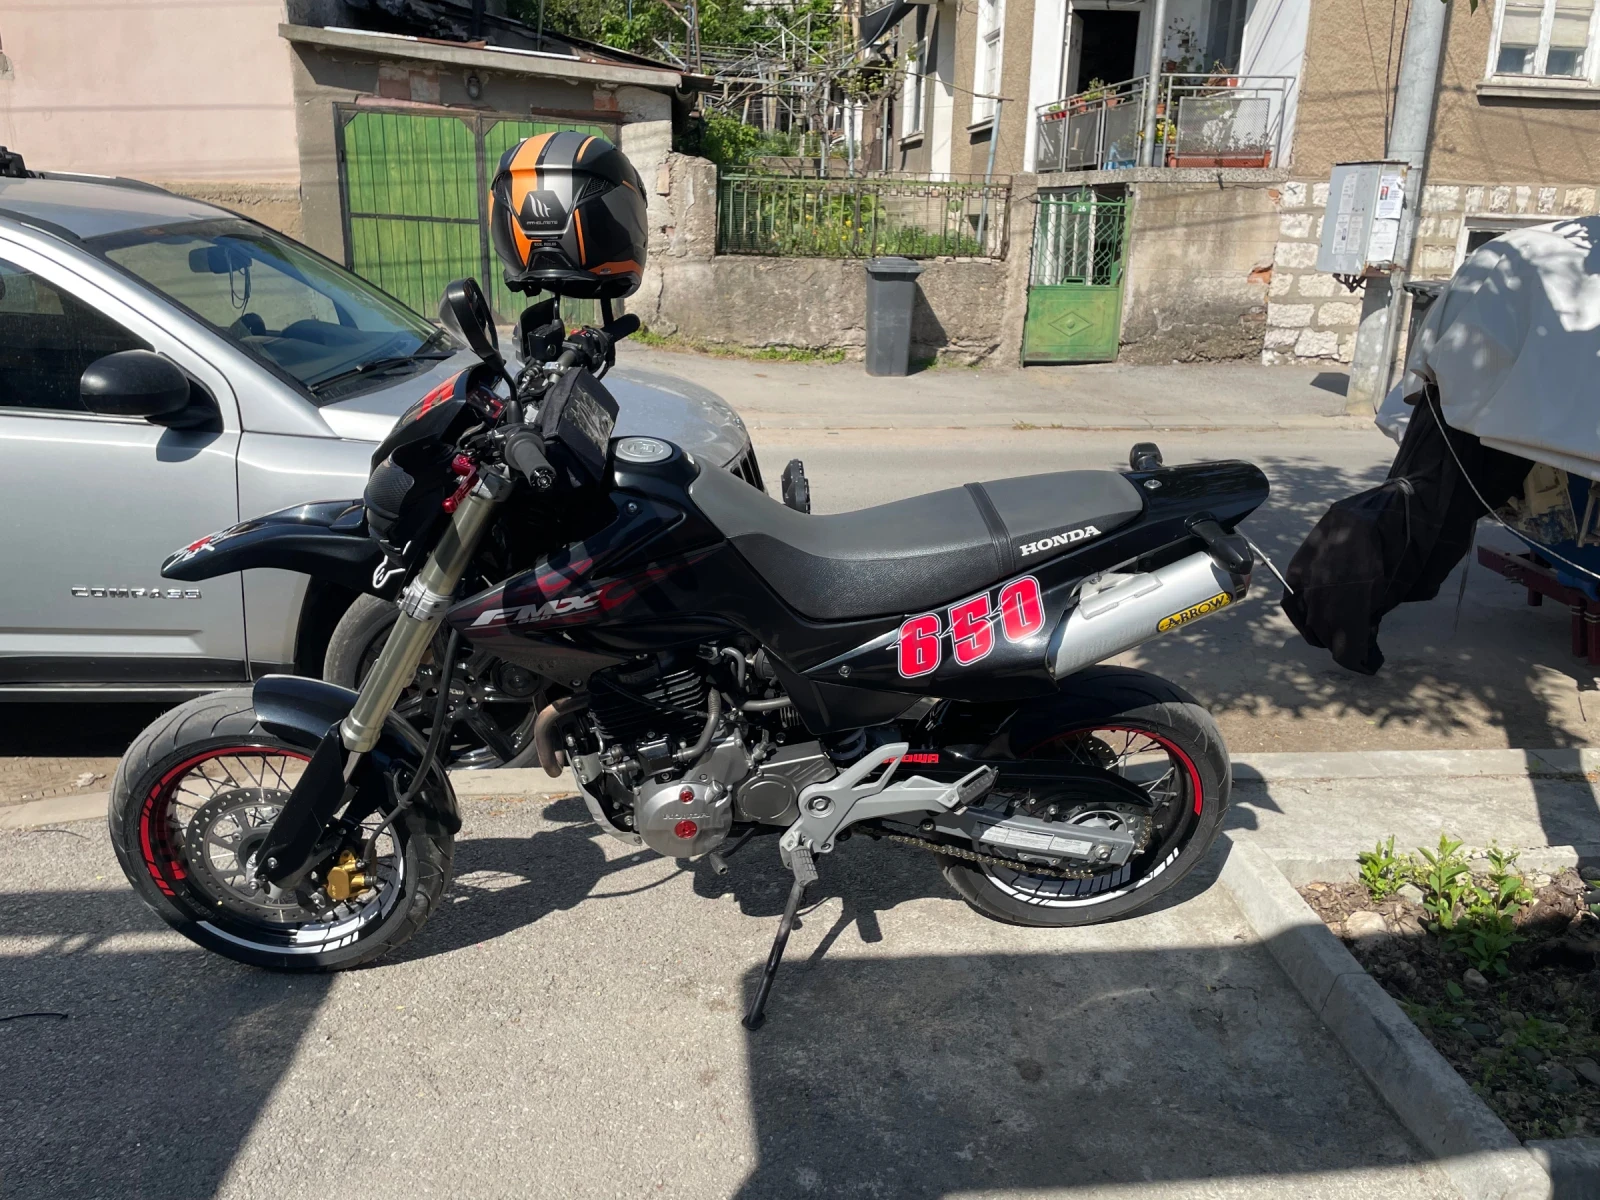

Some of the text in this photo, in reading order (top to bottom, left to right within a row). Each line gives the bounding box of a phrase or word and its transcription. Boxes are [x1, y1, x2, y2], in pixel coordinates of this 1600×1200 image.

[1019, 525, 1102, 557] HONDA
[71, 586, 202, 599] COMPASS
[470, 589, 603, 627] FMX
[885, 574, 1046, 679] 650
[1166, 594, 1226, 629] ARROW
